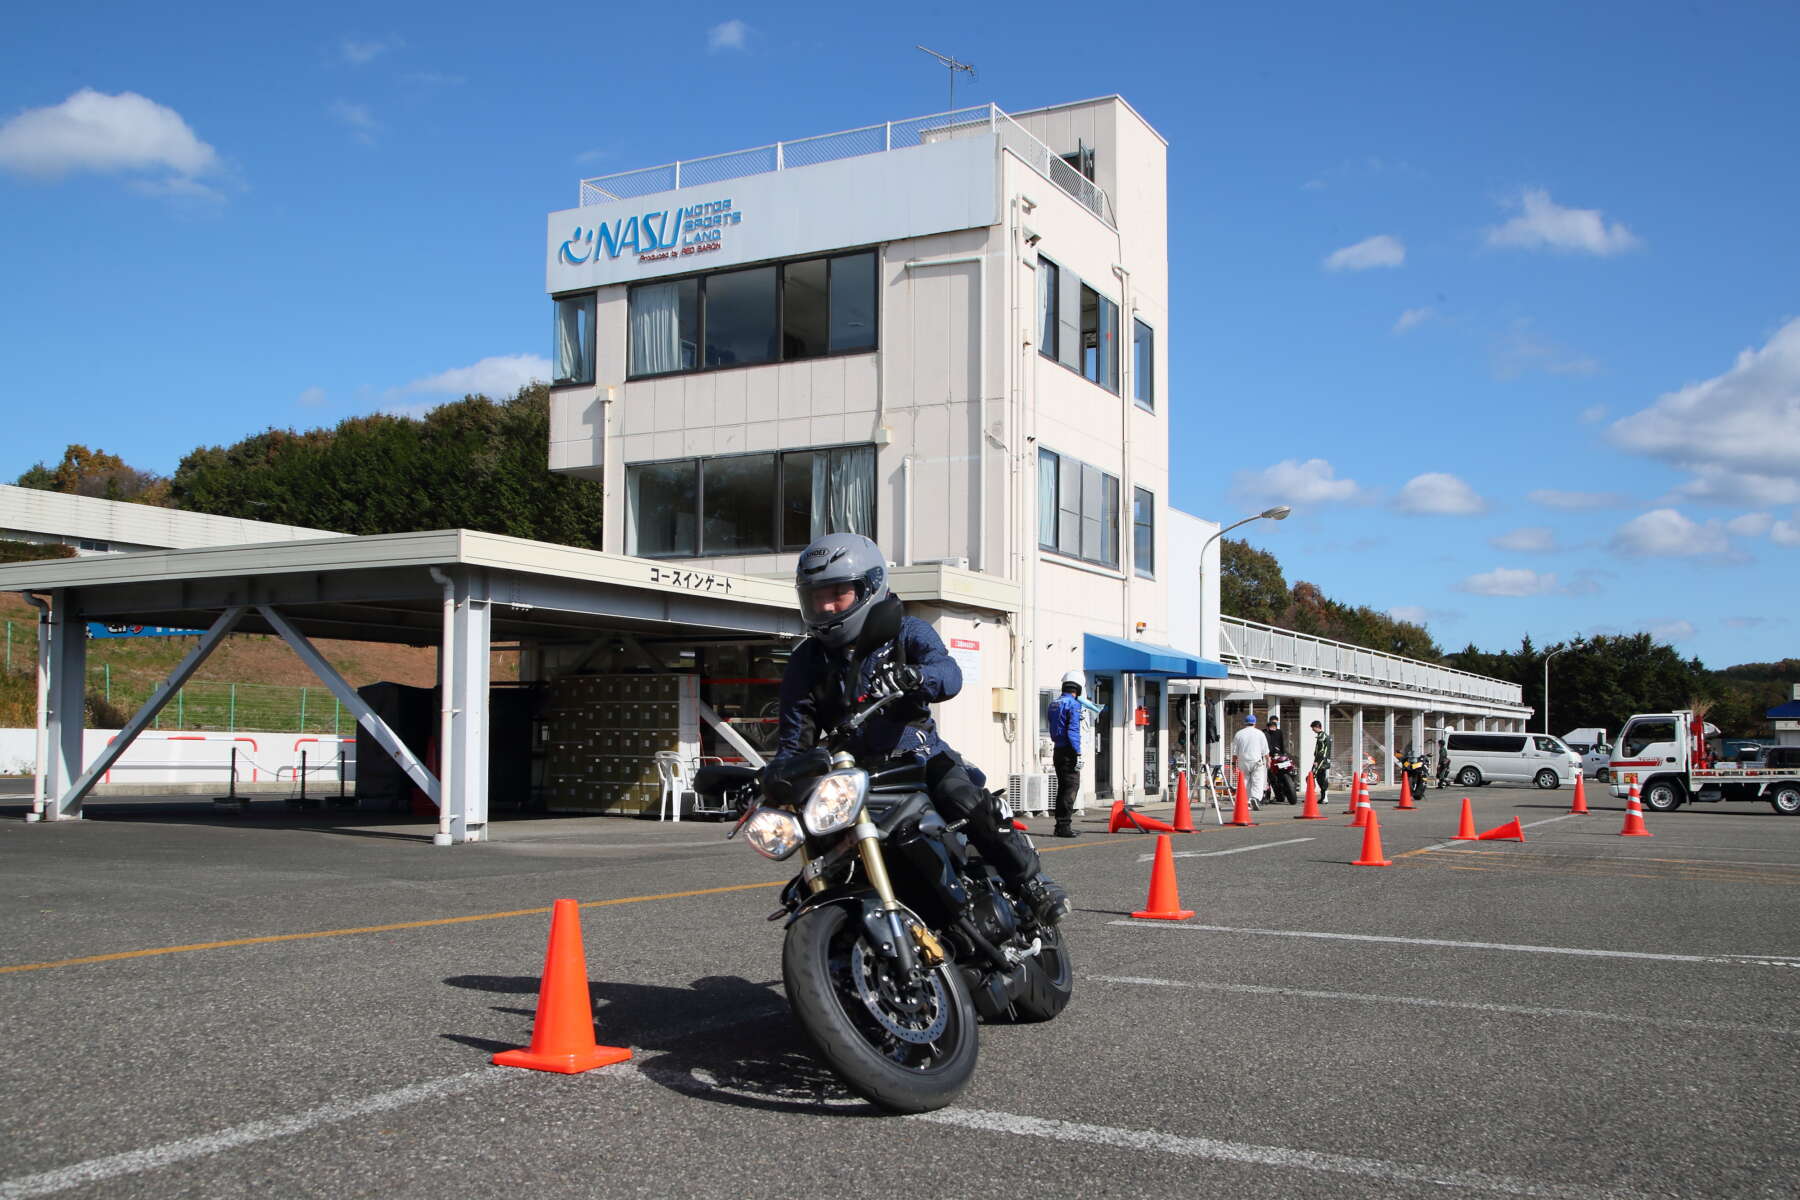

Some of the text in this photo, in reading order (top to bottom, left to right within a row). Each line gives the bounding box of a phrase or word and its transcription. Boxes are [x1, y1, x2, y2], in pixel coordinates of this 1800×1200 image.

[685, 199, 731, 217] MOTOR
[684, 211, 741, 231] SPORTS
[594, 208, 683, 261] NASU
[683, 229, 720, 246] LAND
[640, 252, 669, 261] Produced
[682, 246, 695, 255] RED
[697, 242, 720, 252] BARON
[651, 568, 731, 593] コースインゲート
